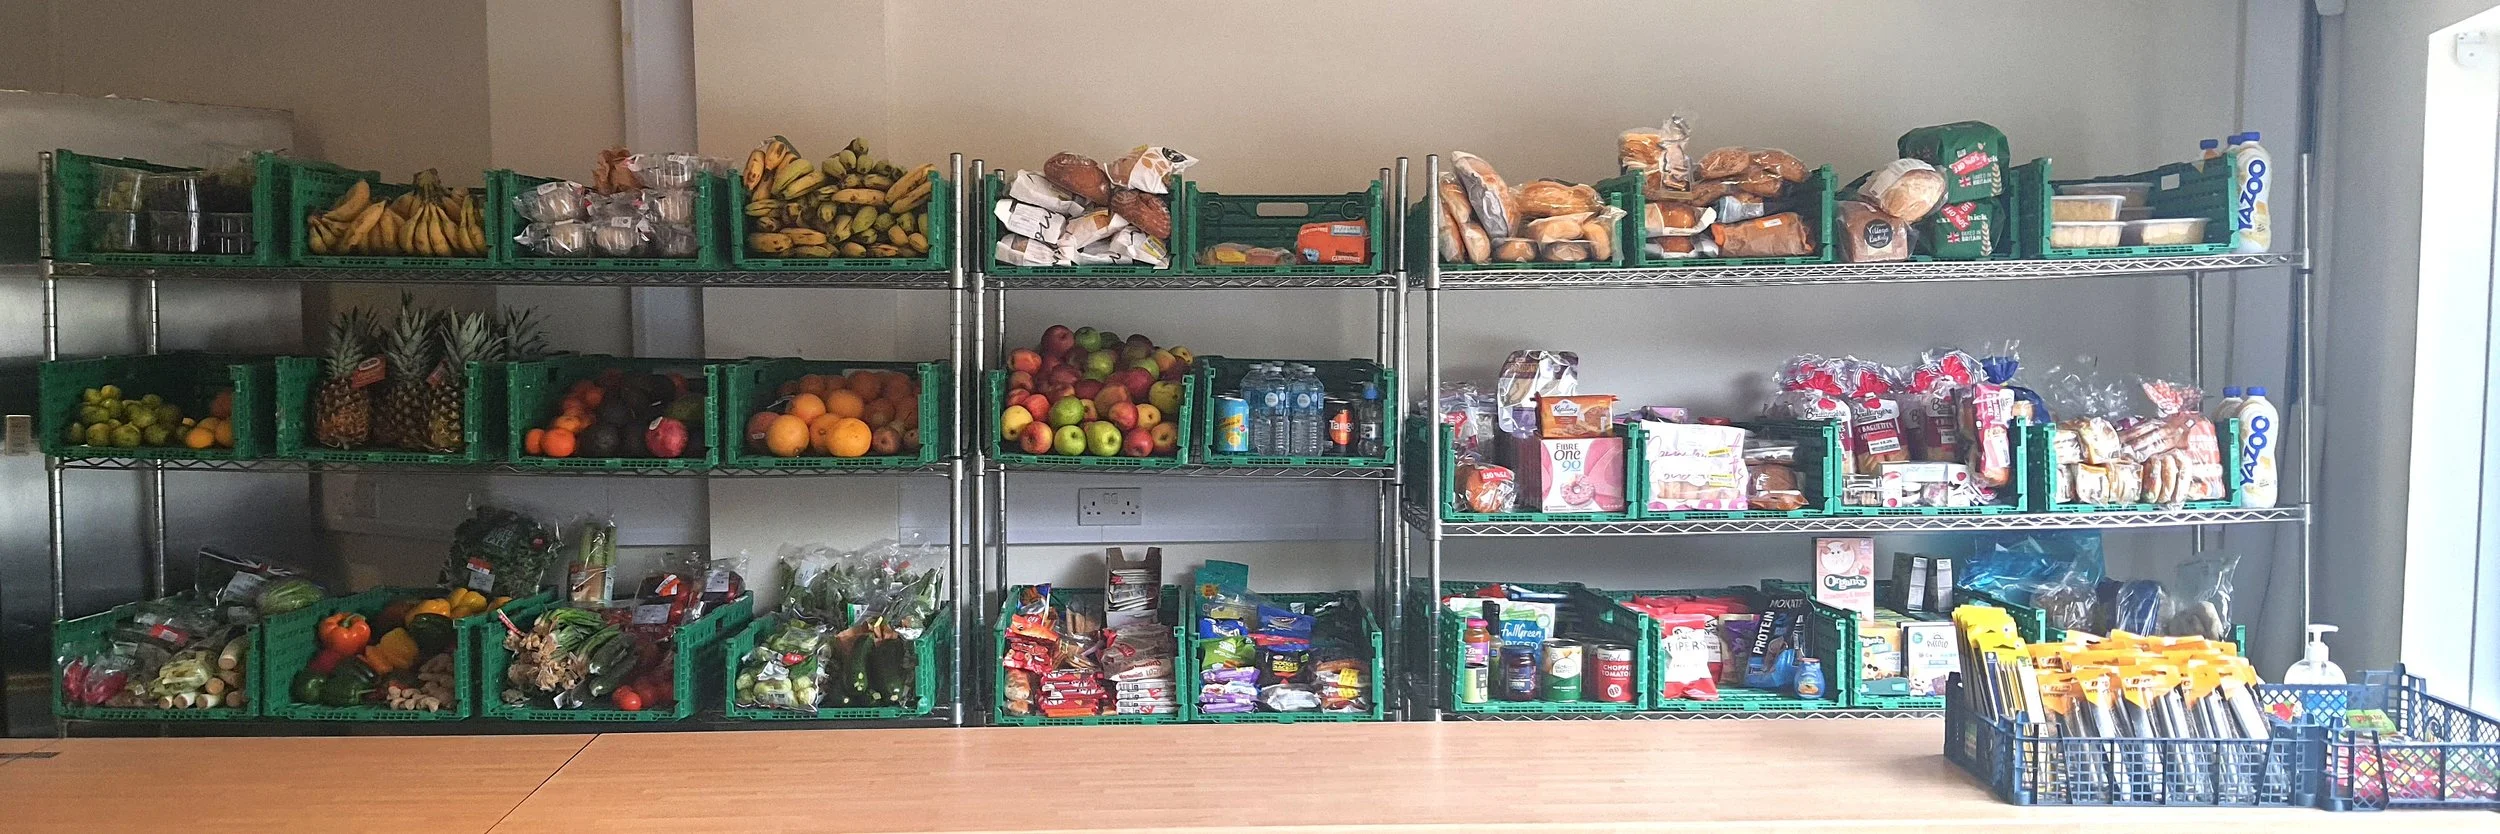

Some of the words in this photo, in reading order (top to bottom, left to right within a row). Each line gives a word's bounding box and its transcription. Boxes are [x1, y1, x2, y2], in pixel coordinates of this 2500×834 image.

[1553, 404, 1578, 415] Kipling
[1553, 450, 1581, 461] One
[2240, 415, 2270, 486] YAZOO
[1562, 461, 1581, 472] 90
[1825, 575, 1866, 590] Organix
[1752, 611, 1775, 654] PROTEIN
